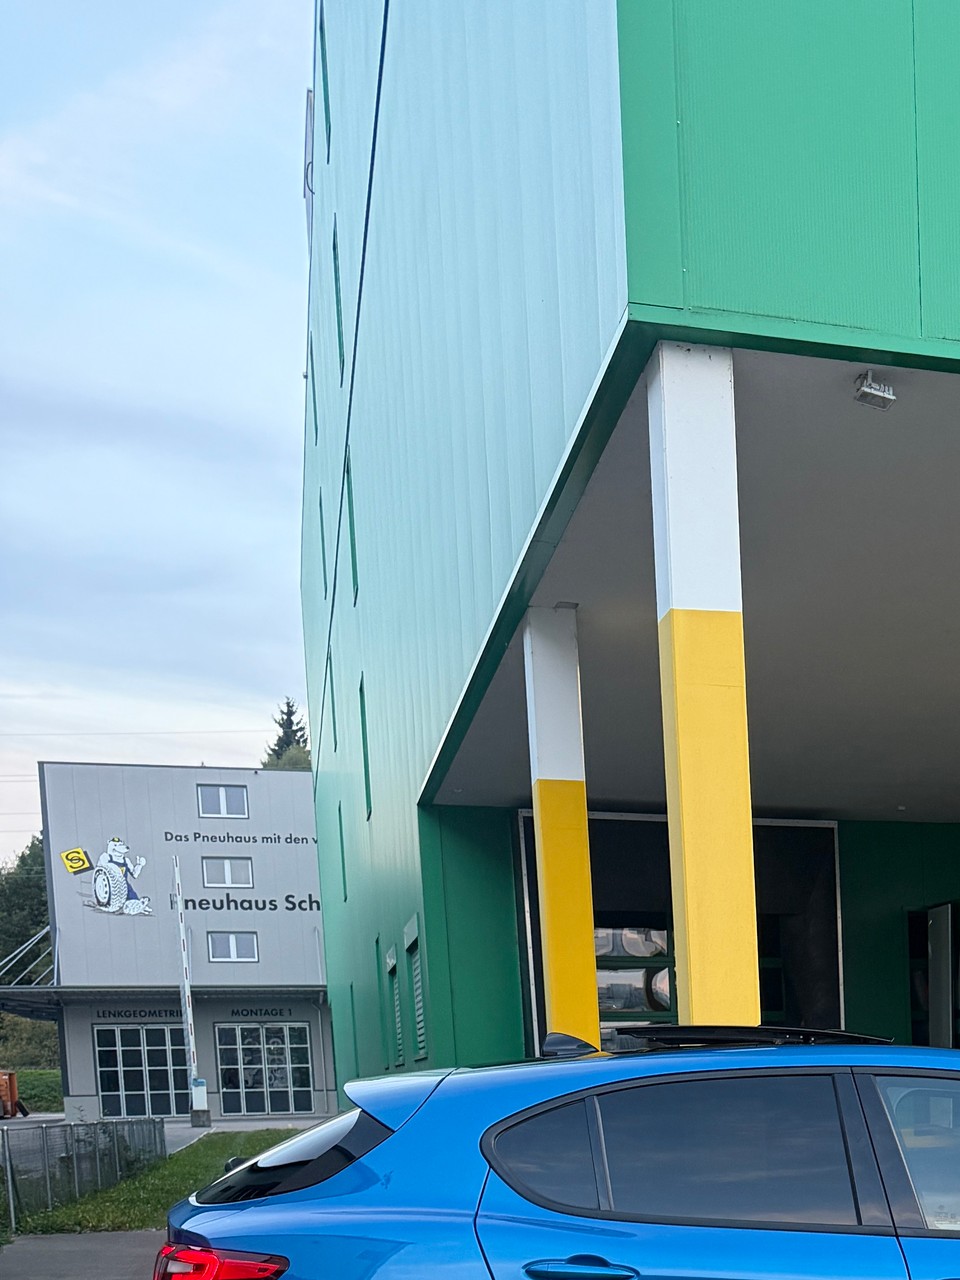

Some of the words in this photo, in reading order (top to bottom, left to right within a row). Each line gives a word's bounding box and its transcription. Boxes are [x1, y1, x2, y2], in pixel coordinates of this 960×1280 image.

[164, 831, 190, 842] Das
[193, 832, 258, 844] Pneuhaus
[261, 833, 281, 844] mit
[284, 833, 309, 844] den
[284, 894, 321, 911] Sch
[231, 1008, 285, 1017] MONTAGE
